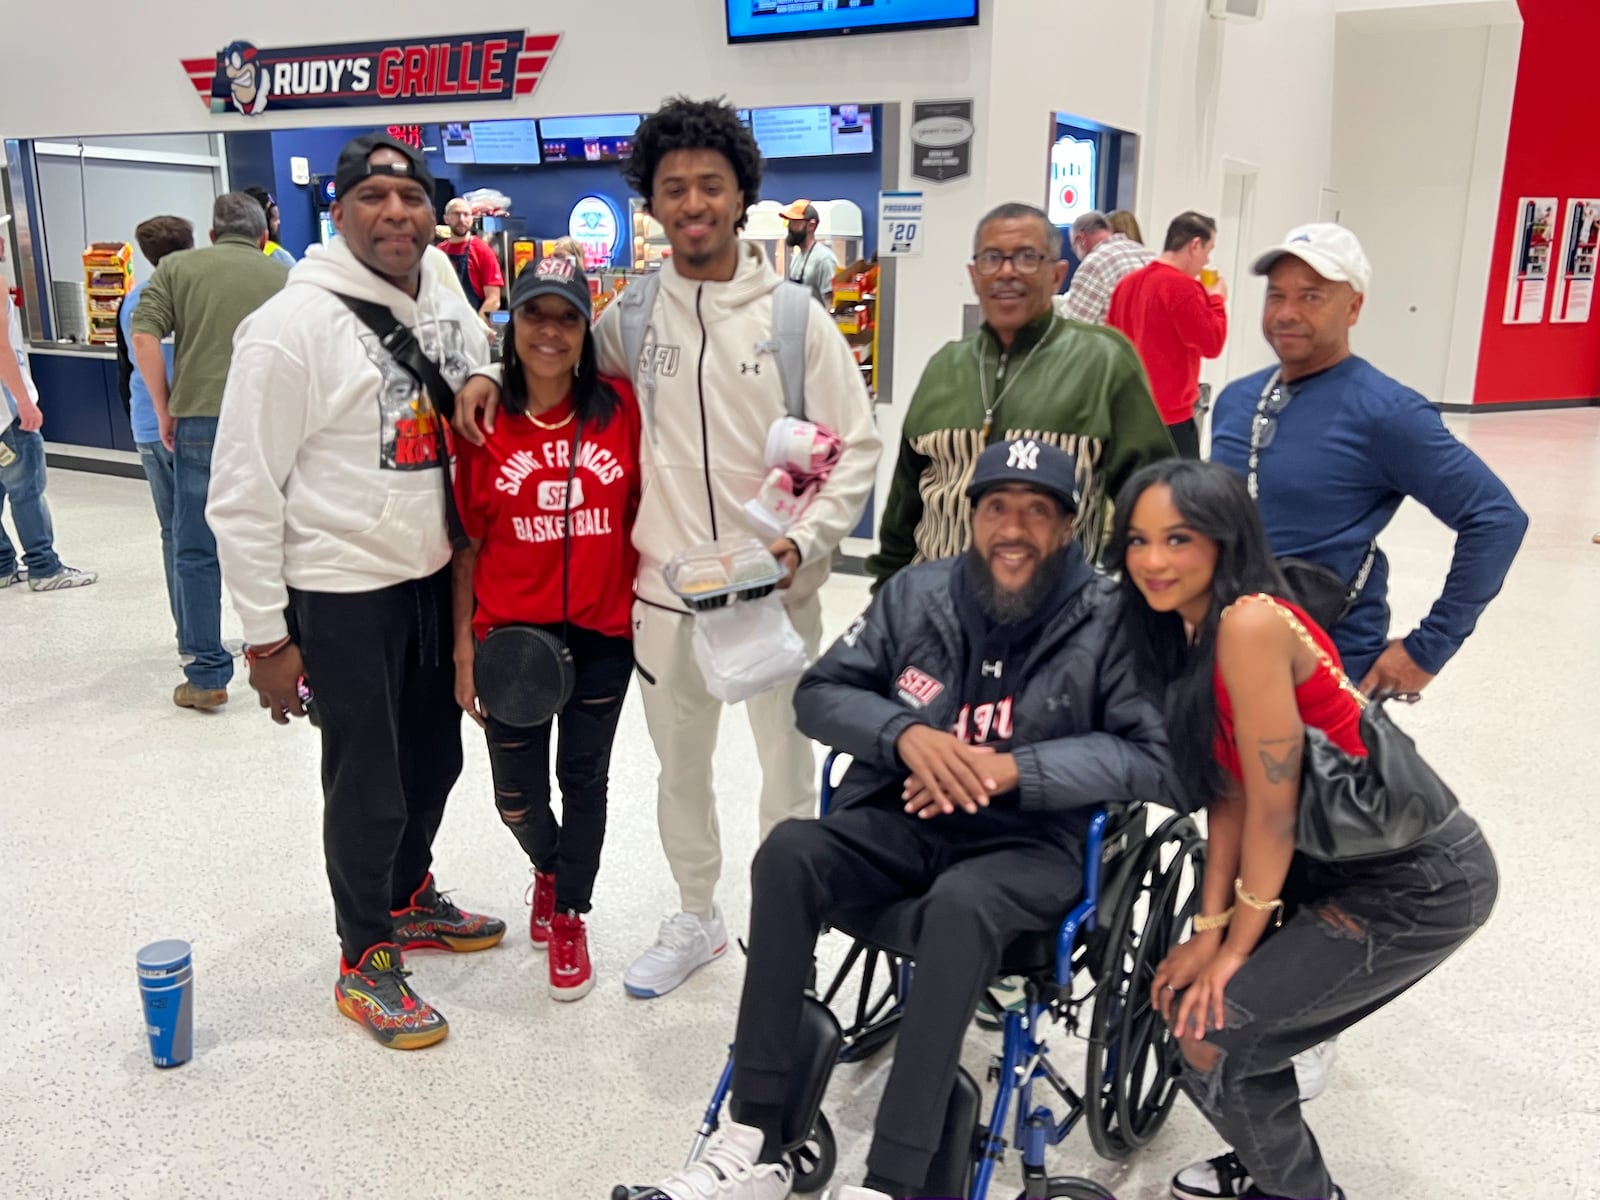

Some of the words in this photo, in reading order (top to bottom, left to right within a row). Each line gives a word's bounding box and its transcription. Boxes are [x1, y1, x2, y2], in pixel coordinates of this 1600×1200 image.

[273, 57, 371, 96] RUDY'S
[375, 38, 508, 99] GRILLE
[883, 204, 922, 213] PROGRAMS
[888, 223, 917, 241] $20
[494, 449, 543, 497] SAINT
[512, 507, 612, 543] BASKETBALL
